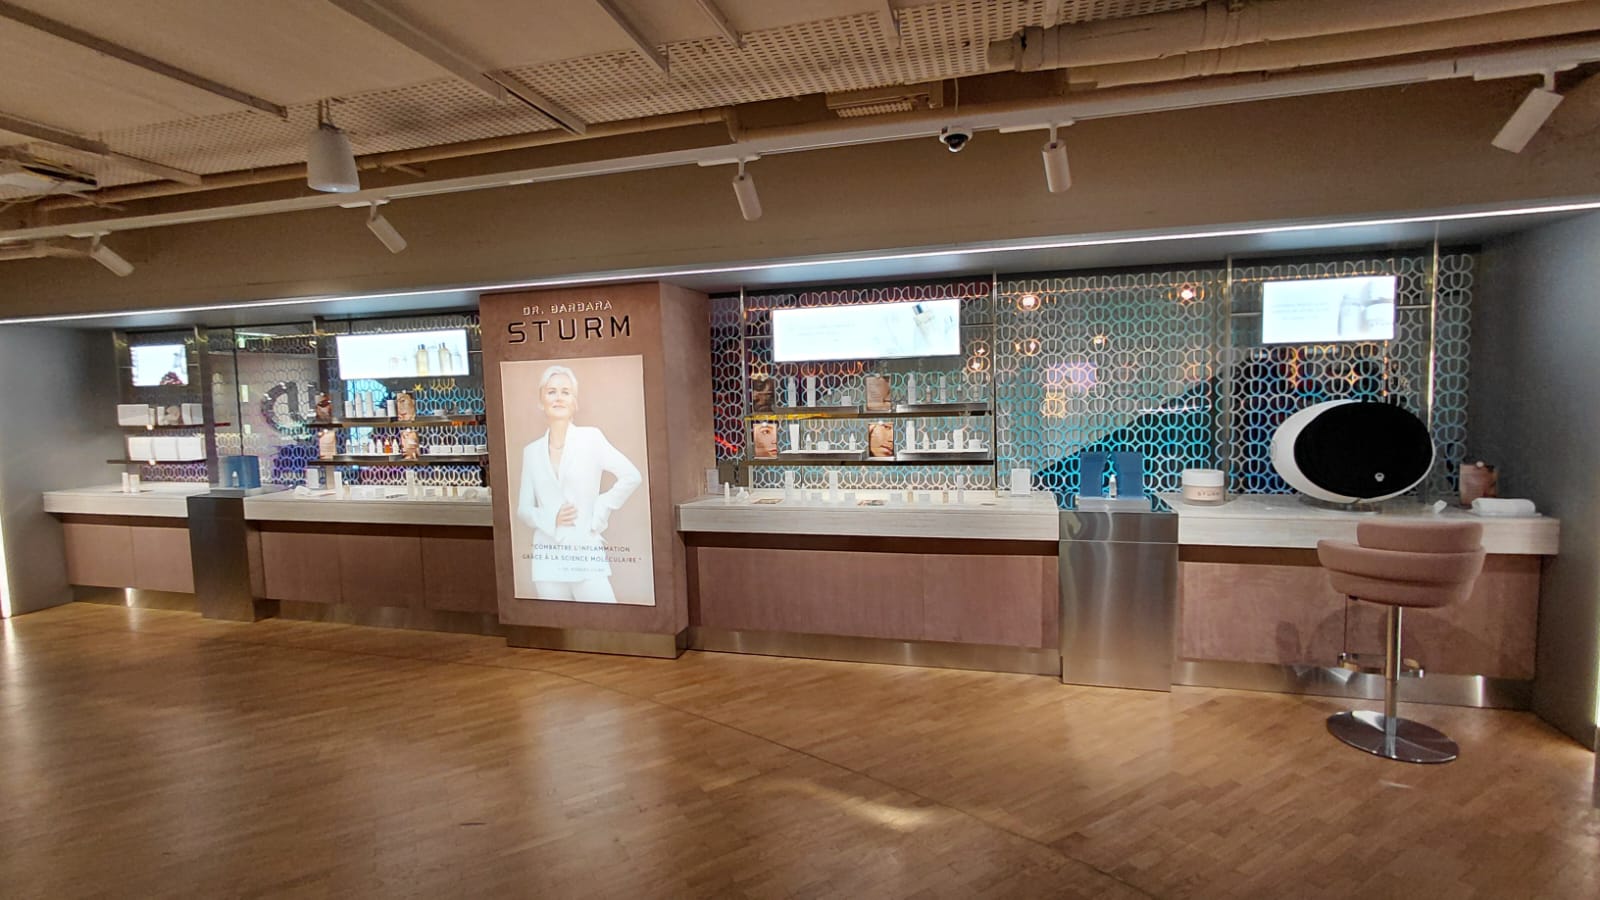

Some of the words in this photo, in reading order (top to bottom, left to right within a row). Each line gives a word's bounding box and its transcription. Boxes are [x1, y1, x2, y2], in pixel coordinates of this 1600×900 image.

[523, 305, 544, 315] DR.
[551, 300, 613, 314] BARBARA
[508, 315, 631, 344] STURM
[561, 554, 588, 562] SCIENCE
